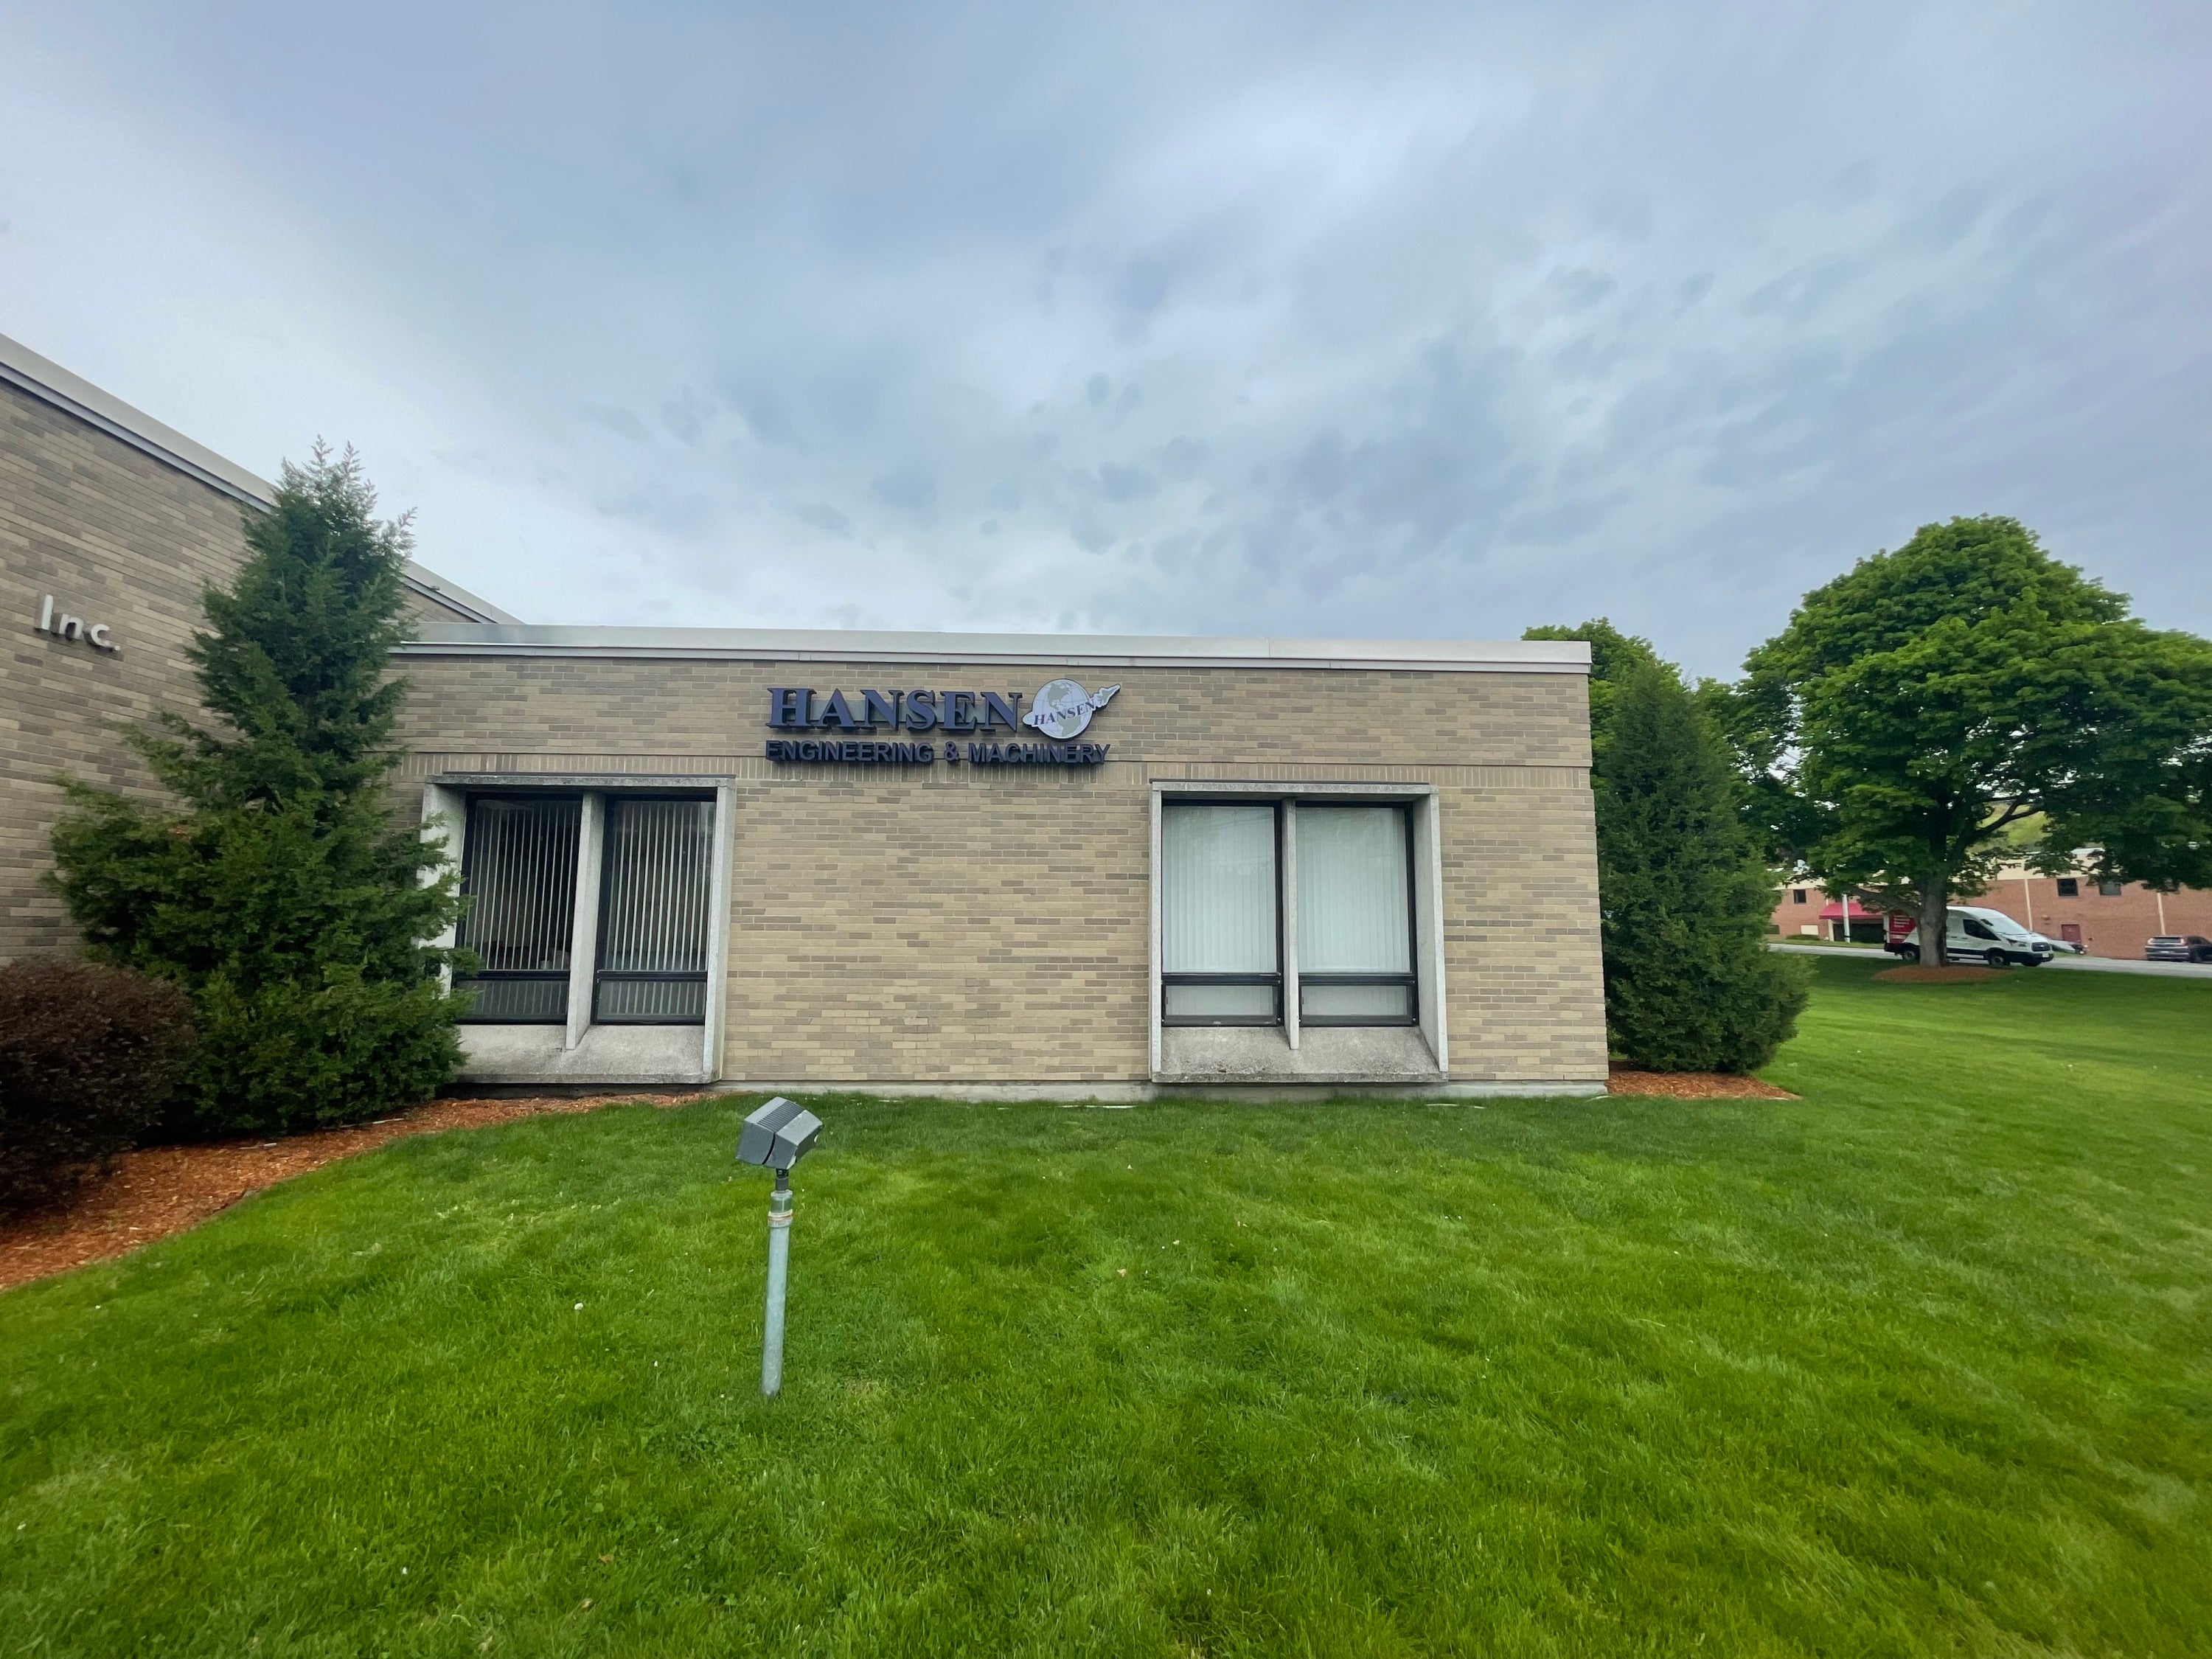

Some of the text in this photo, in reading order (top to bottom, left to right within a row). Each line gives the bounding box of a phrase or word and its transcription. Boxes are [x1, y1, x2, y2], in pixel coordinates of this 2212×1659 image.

[41, 594, 121, 651] Inc.
[765, 686, 1023, 733] HANSEN
[1034, 698, 1095, 726] HANSEN
[765, 740, 1111, 765] ENGINEERING & MACHINERY
